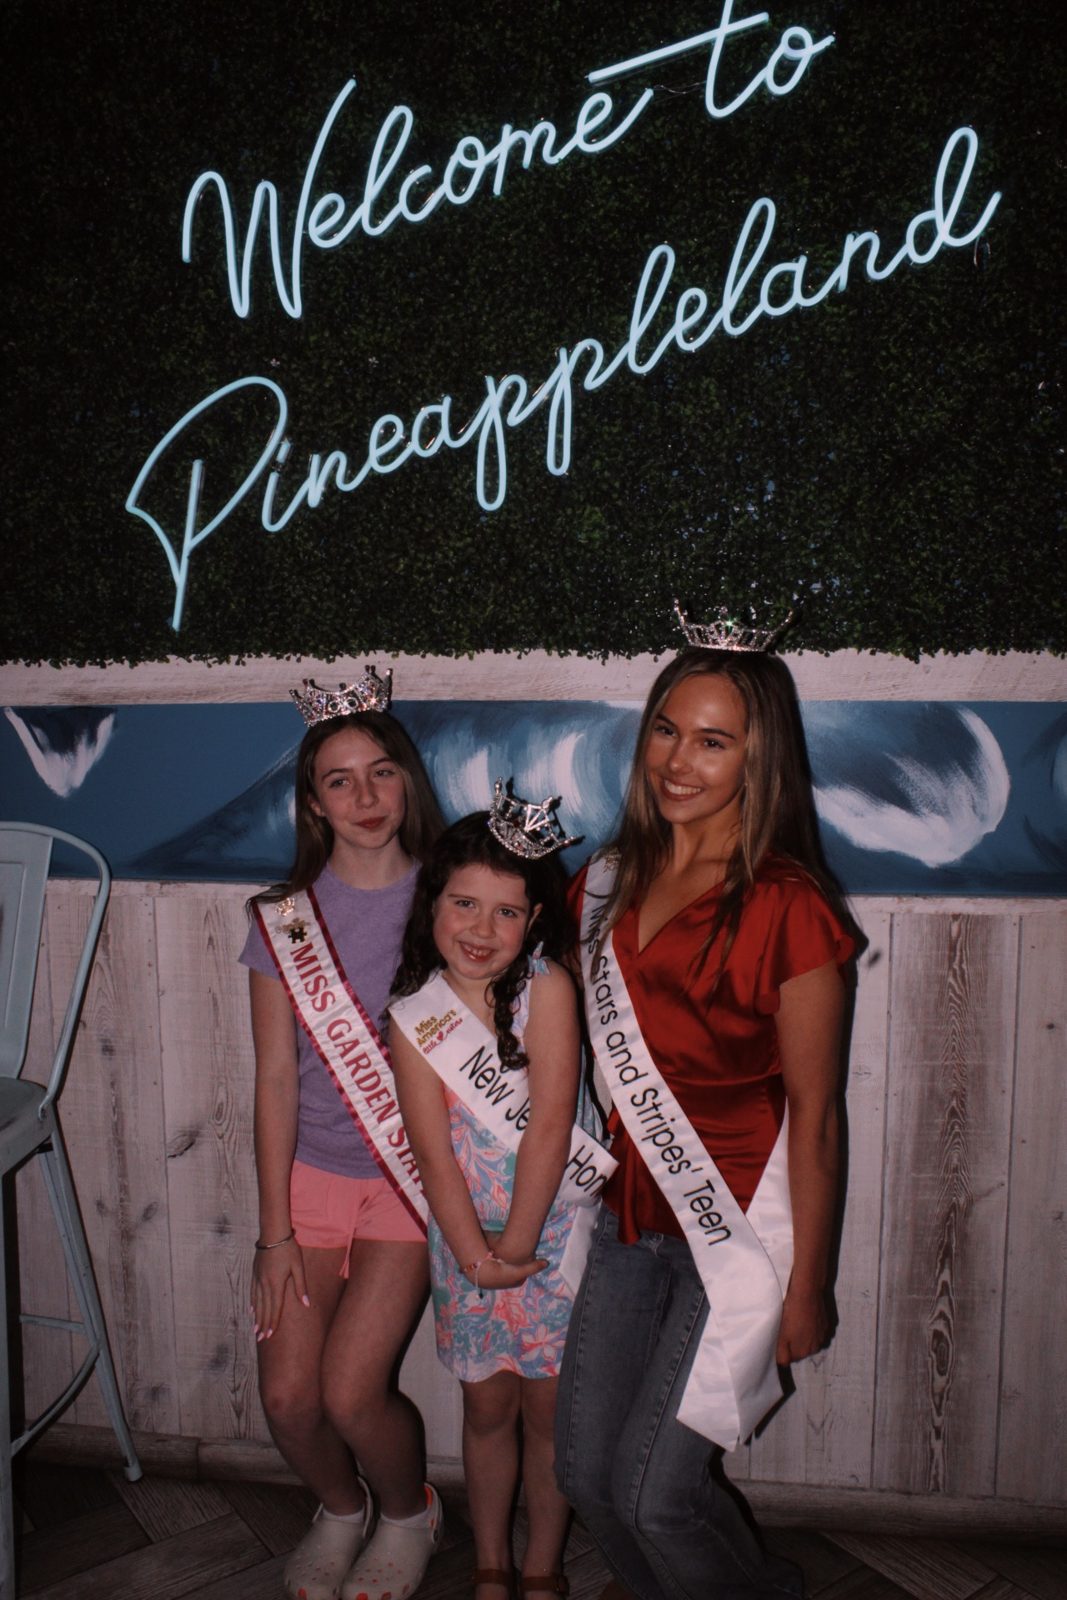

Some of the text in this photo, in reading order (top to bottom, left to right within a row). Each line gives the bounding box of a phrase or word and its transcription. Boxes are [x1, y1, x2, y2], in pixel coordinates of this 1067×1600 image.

[181, 0, 836, 318] Welcome to
[125, 127, 1002, 632] Pineappleland
[290, 942, 336, 1013] MISS
[326, 1018, 402, 1125] GARDEN
[415, 1016, 437, 1036] Miss
[459, 1045, 515, 1106] New
[592, 955, 618, 1026] Stars
[606, 1030, 649, 1086] and
[630, 1087, 704, 1175] Stripes'
[683, 1179, 732, 1246] Teen
